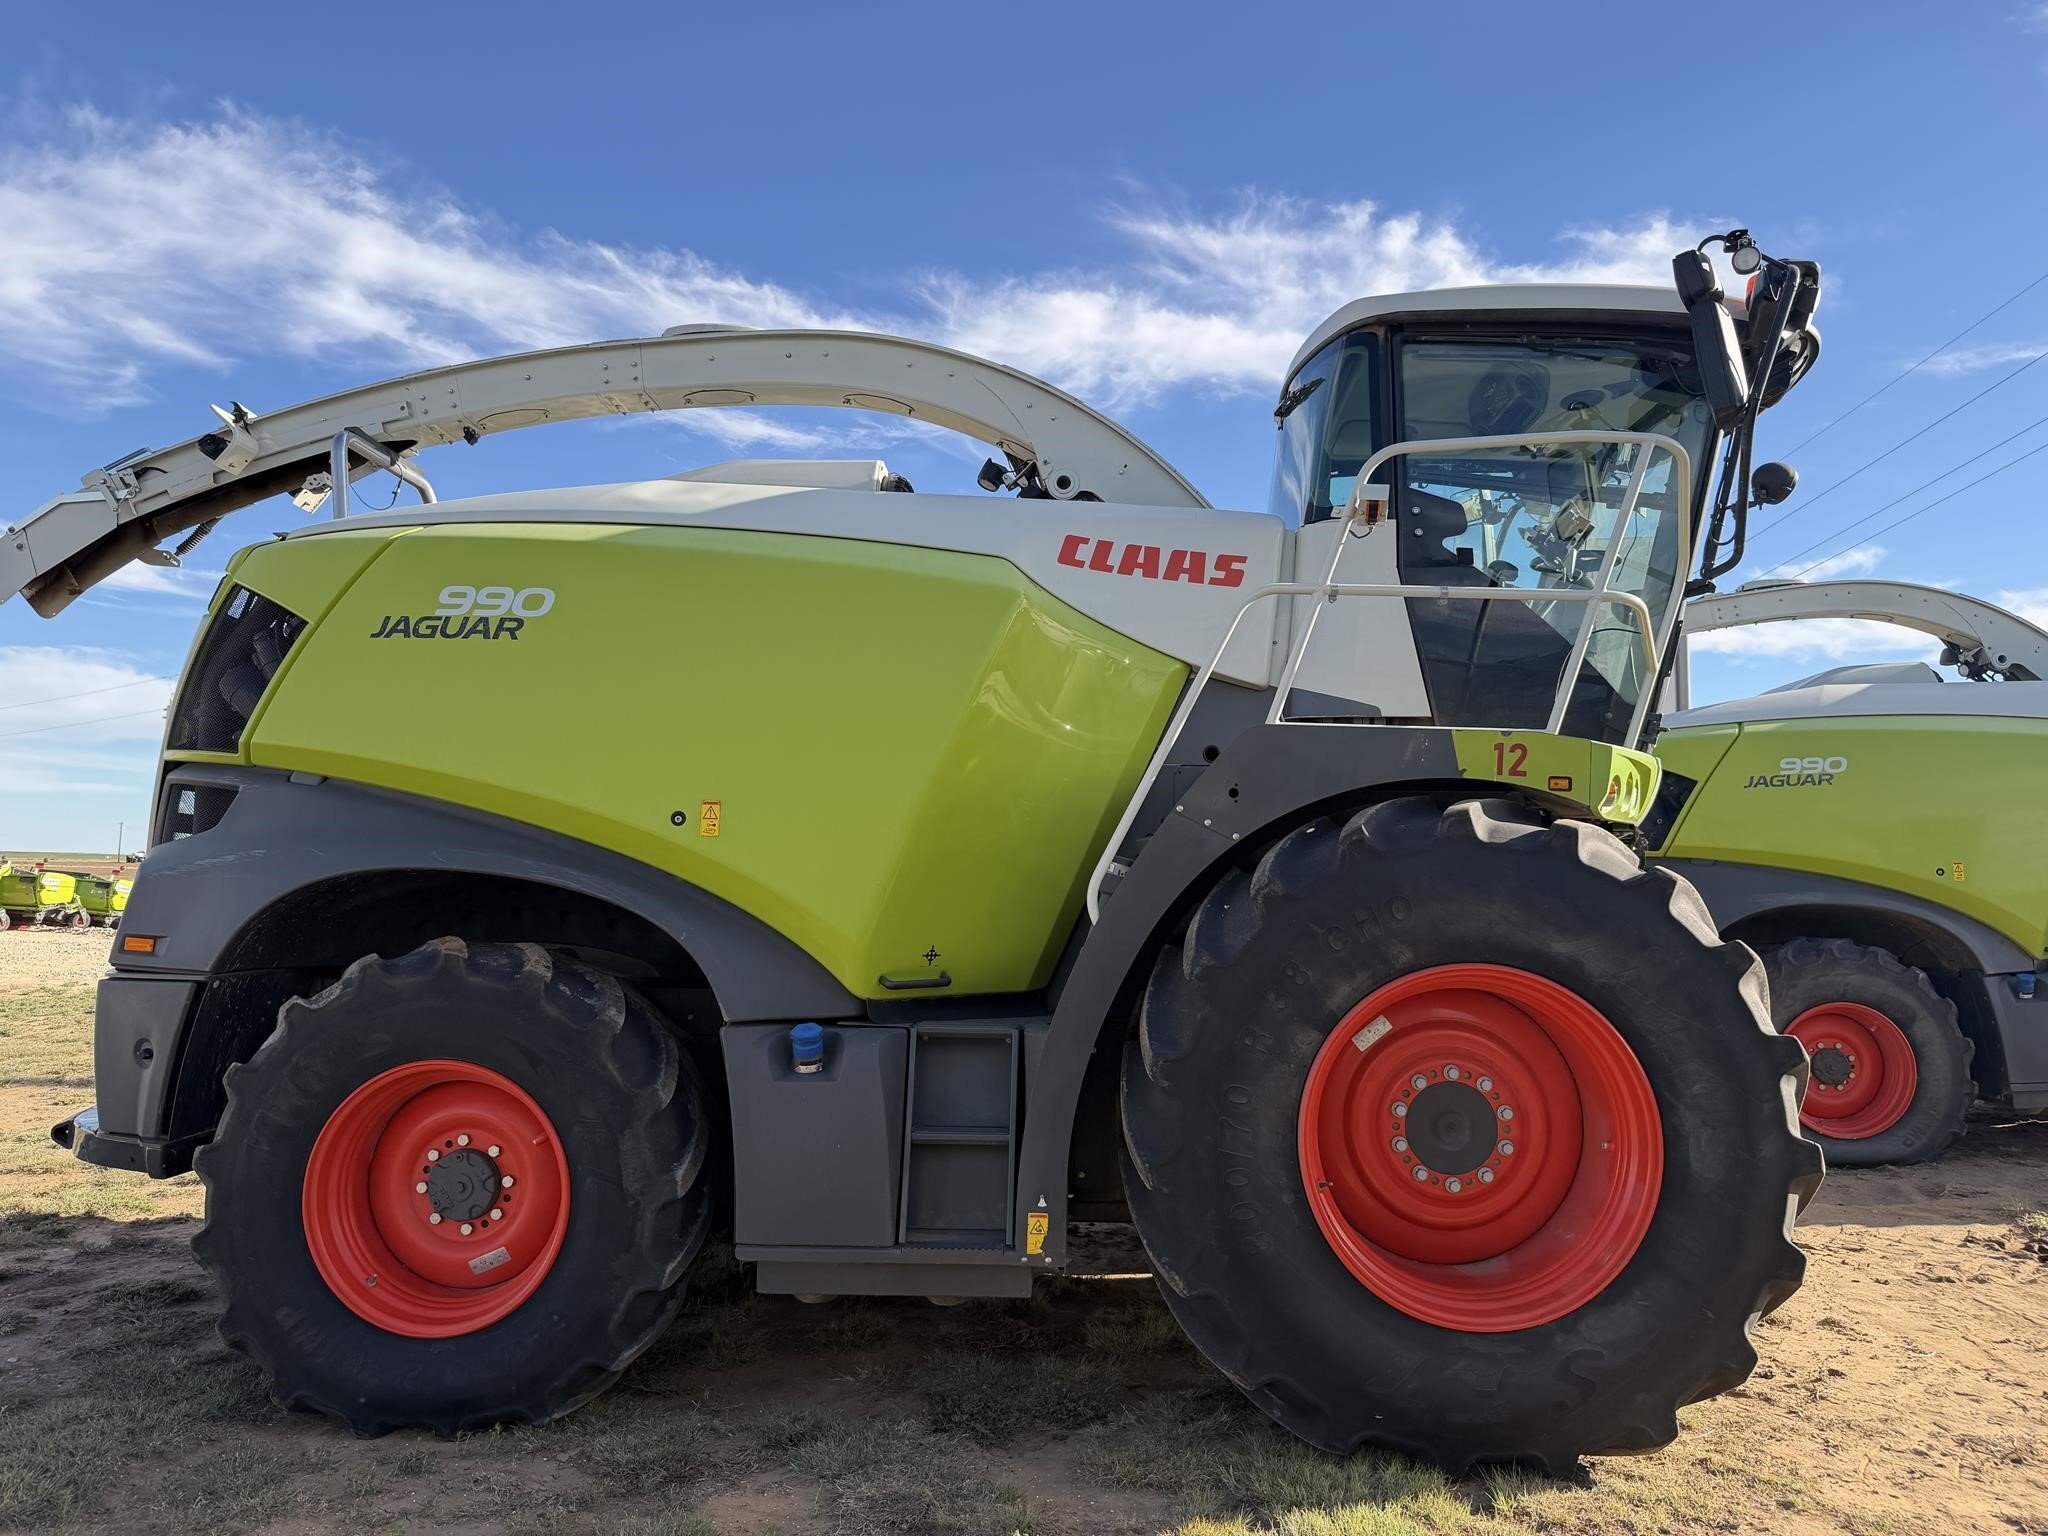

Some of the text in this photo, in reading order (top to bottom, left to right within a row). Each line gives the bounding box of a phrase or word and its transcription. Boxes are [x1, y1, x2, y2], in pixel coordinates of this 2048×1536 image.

[1056, 534, 1249, 588] CLAAS
[434, 585, 556, 617] 990
[370, 615, 525, 640] JAGUAR
[1493, 742, 1528, 777] 12
[1779, 756, 1848, 775] 990
[1743, 773, 1835, 789] JAGUAR
